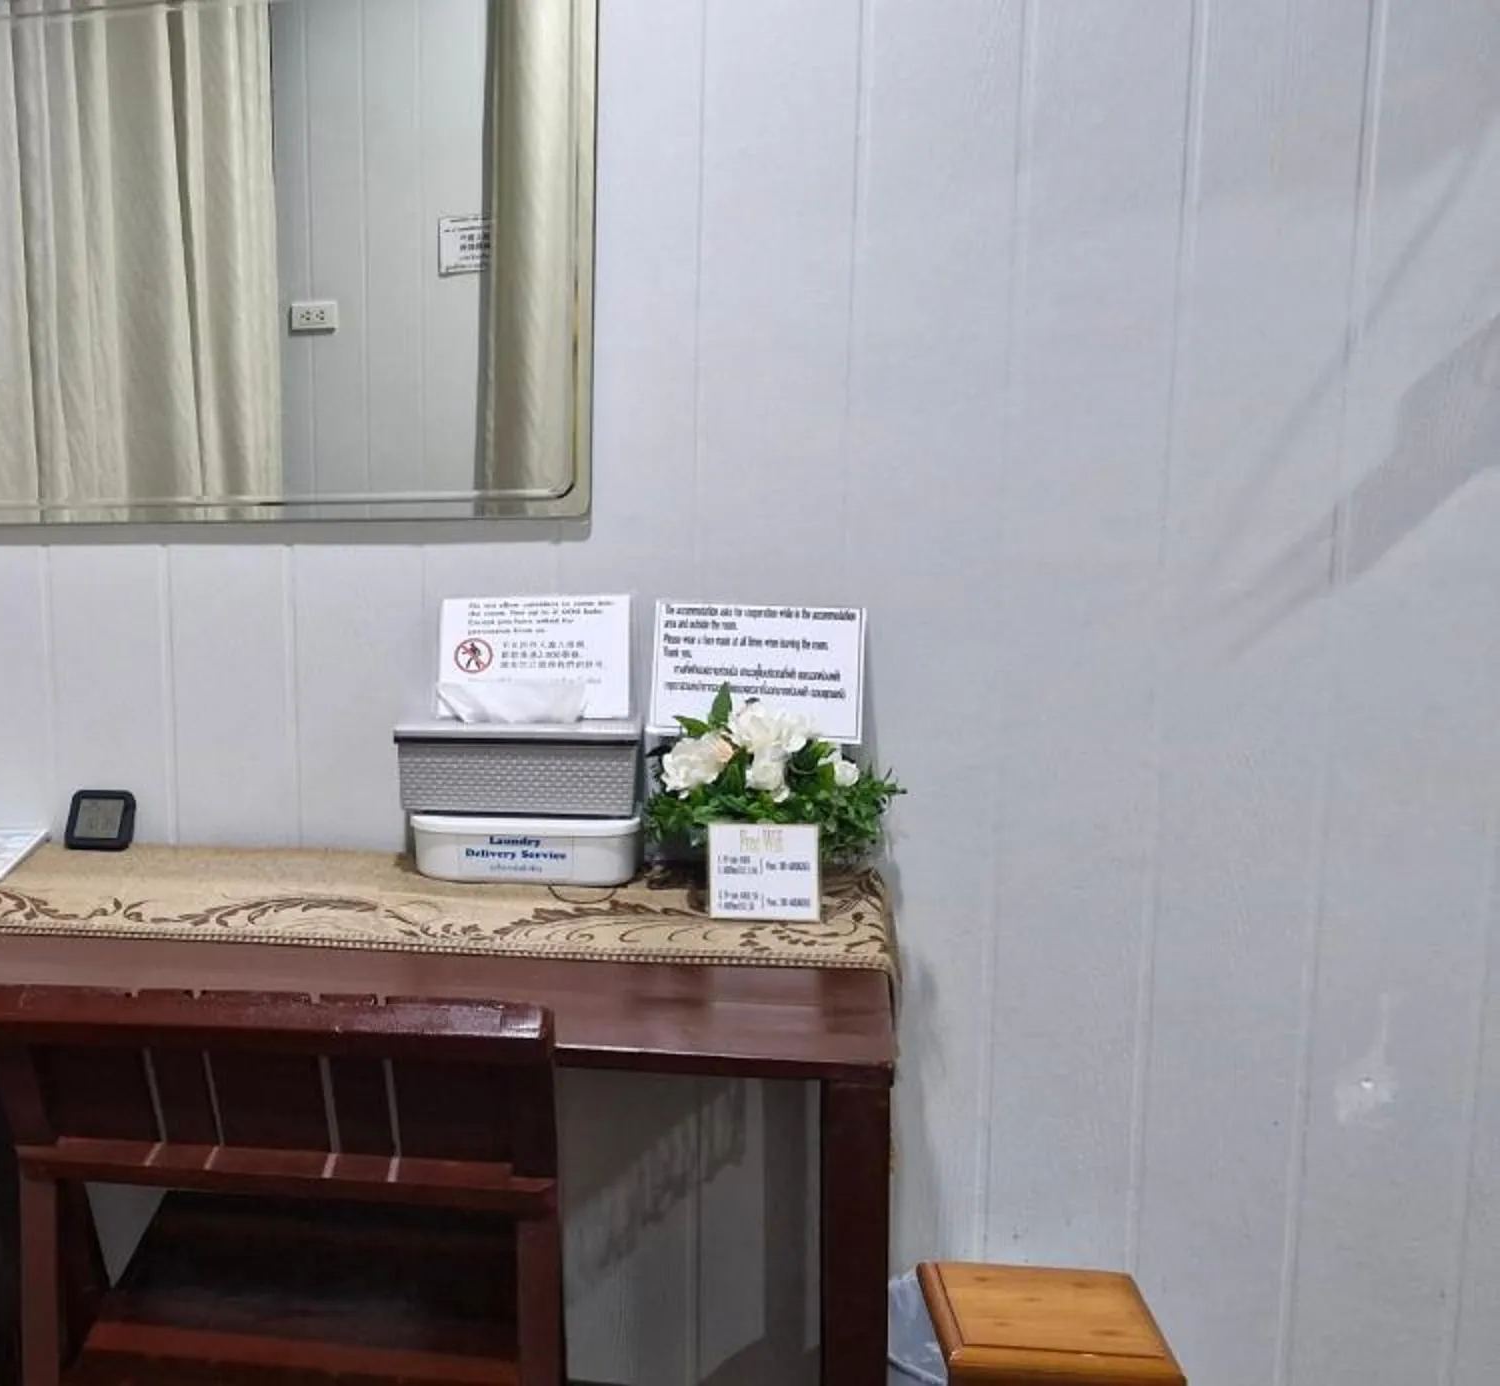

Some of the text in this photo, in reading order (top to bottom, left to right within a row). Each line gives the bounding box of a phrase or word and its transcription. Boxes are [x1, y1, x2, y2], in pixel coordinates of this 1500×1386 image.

[489, 835, 541, 848] Laundry
[465, 847, 567, 860] Delivery Service
